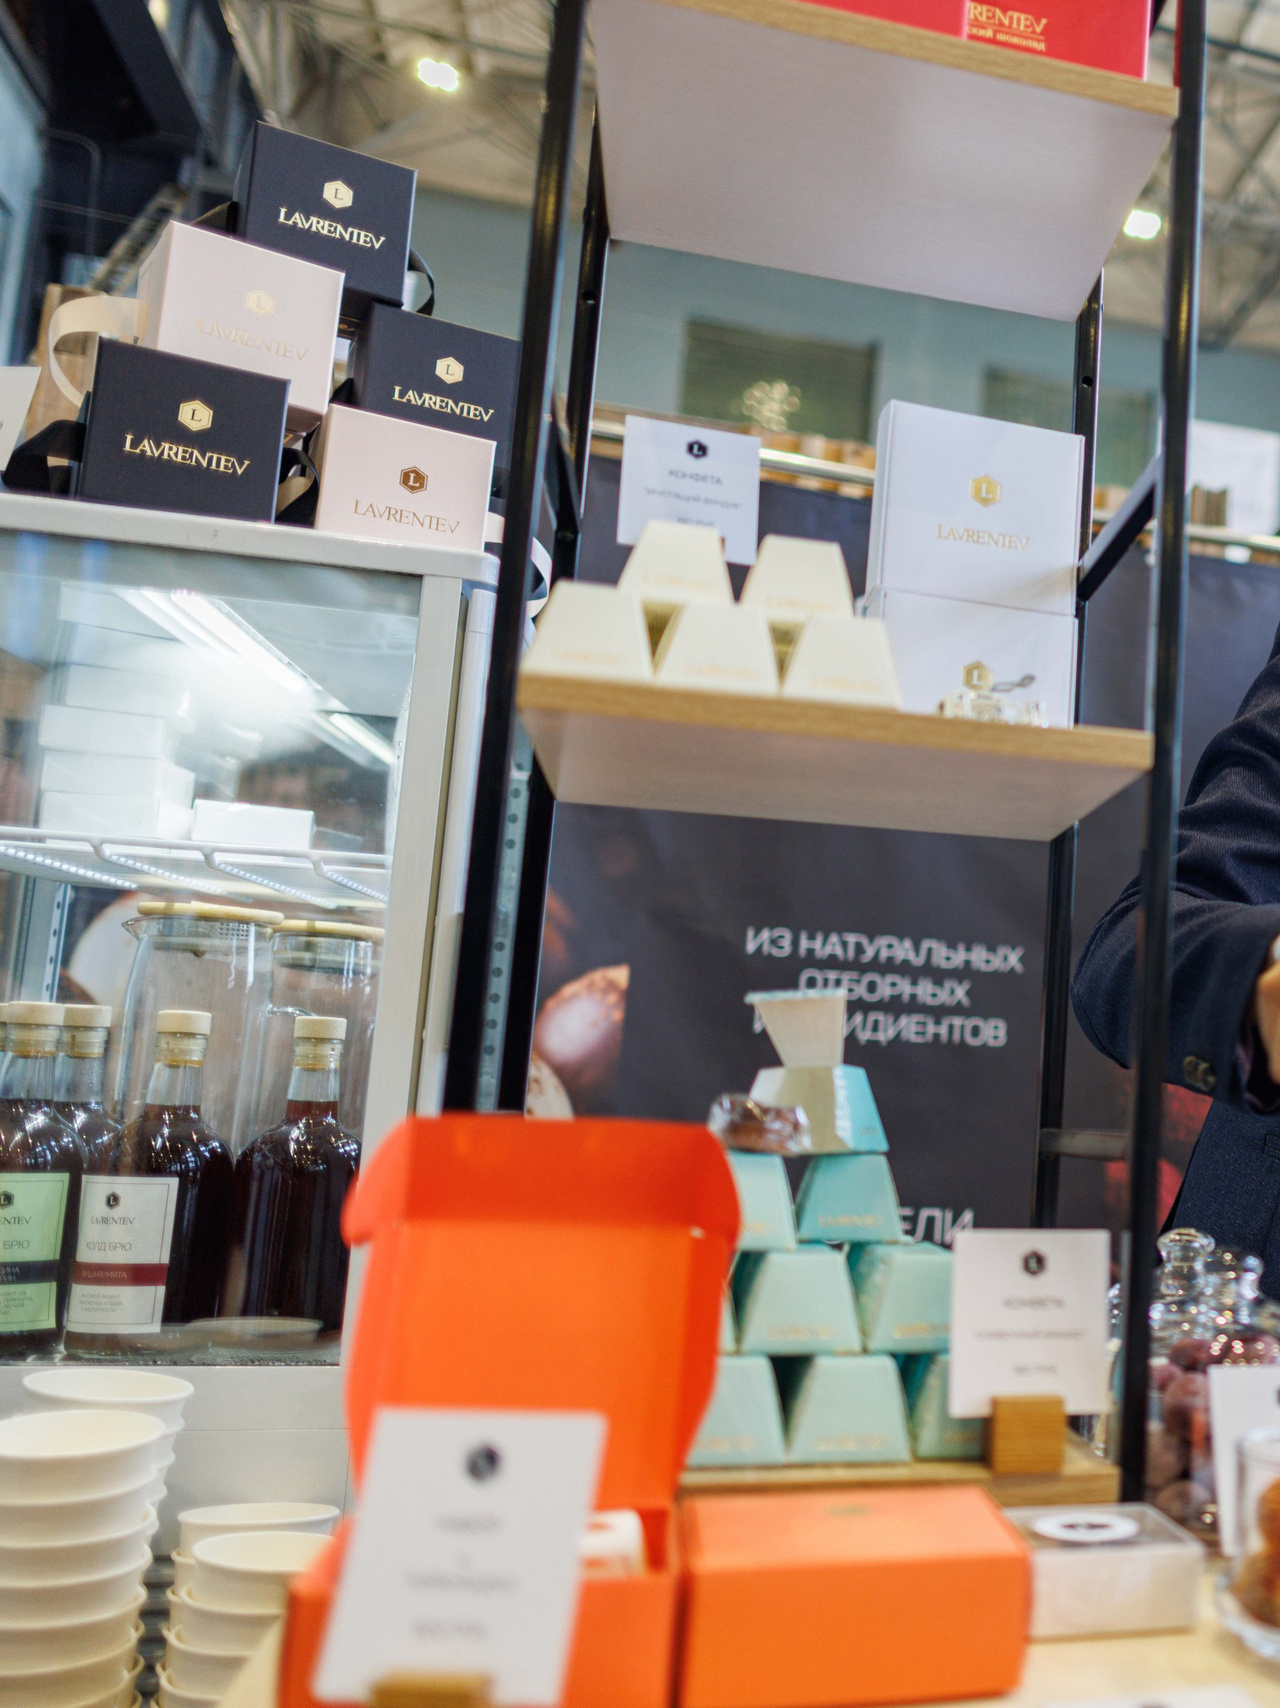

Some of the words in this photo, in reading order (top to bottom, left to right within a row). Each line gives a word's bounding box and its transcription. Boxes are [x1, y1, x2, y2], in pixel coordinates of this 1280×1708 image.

[277, 207, 386, 250] LAVRENTEV
[195, 315, 309, 363] LAVRENTEV
[393, 385, 495, 423] LAVRENTEV
[122, 433, 251, 476] LAVRENTEV
[668, 469, 723, 486] КОНФЕТА
[353, 498, 460, 535] LAVRENTEV
[936, 523, 1031, 552] LAVRENTEV
[746, 926, 793, 958] ИЗ
[799, 929, 1026, 975] НАТУРАЛЬНЫХ
[799, 967, 973, 1008] ОТБОРНЫХ
[91, 1216, 136, 1226] LAVRENTEV
[108, 1241, 133, 1252] БРЮ
